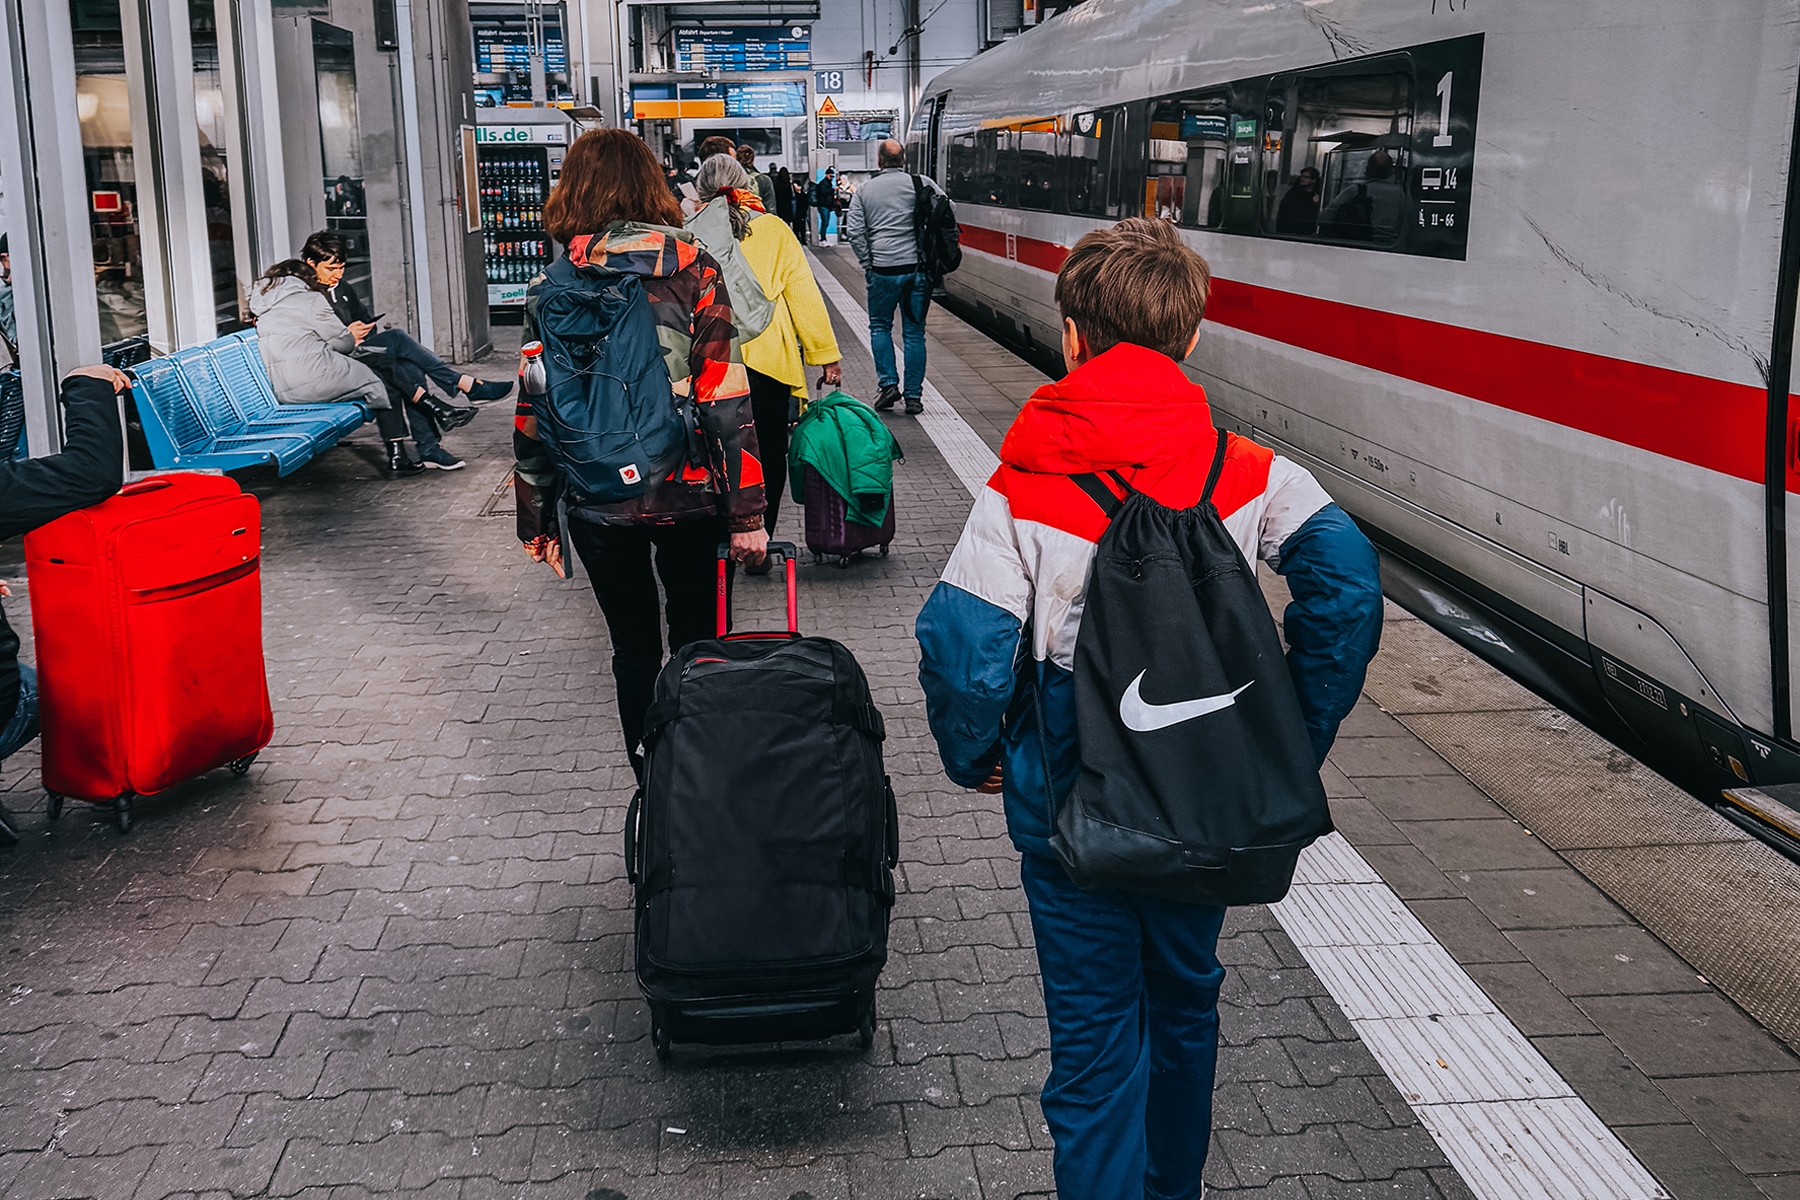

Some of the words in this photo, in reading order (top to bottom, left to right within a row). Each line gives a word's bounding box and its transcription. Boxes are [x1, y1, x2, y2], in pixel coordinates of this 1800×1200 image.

[821, 72, 841, 89] 18
[1433, 71, 1453, 147] 1
[1444, 168, 1457, 189] 14
